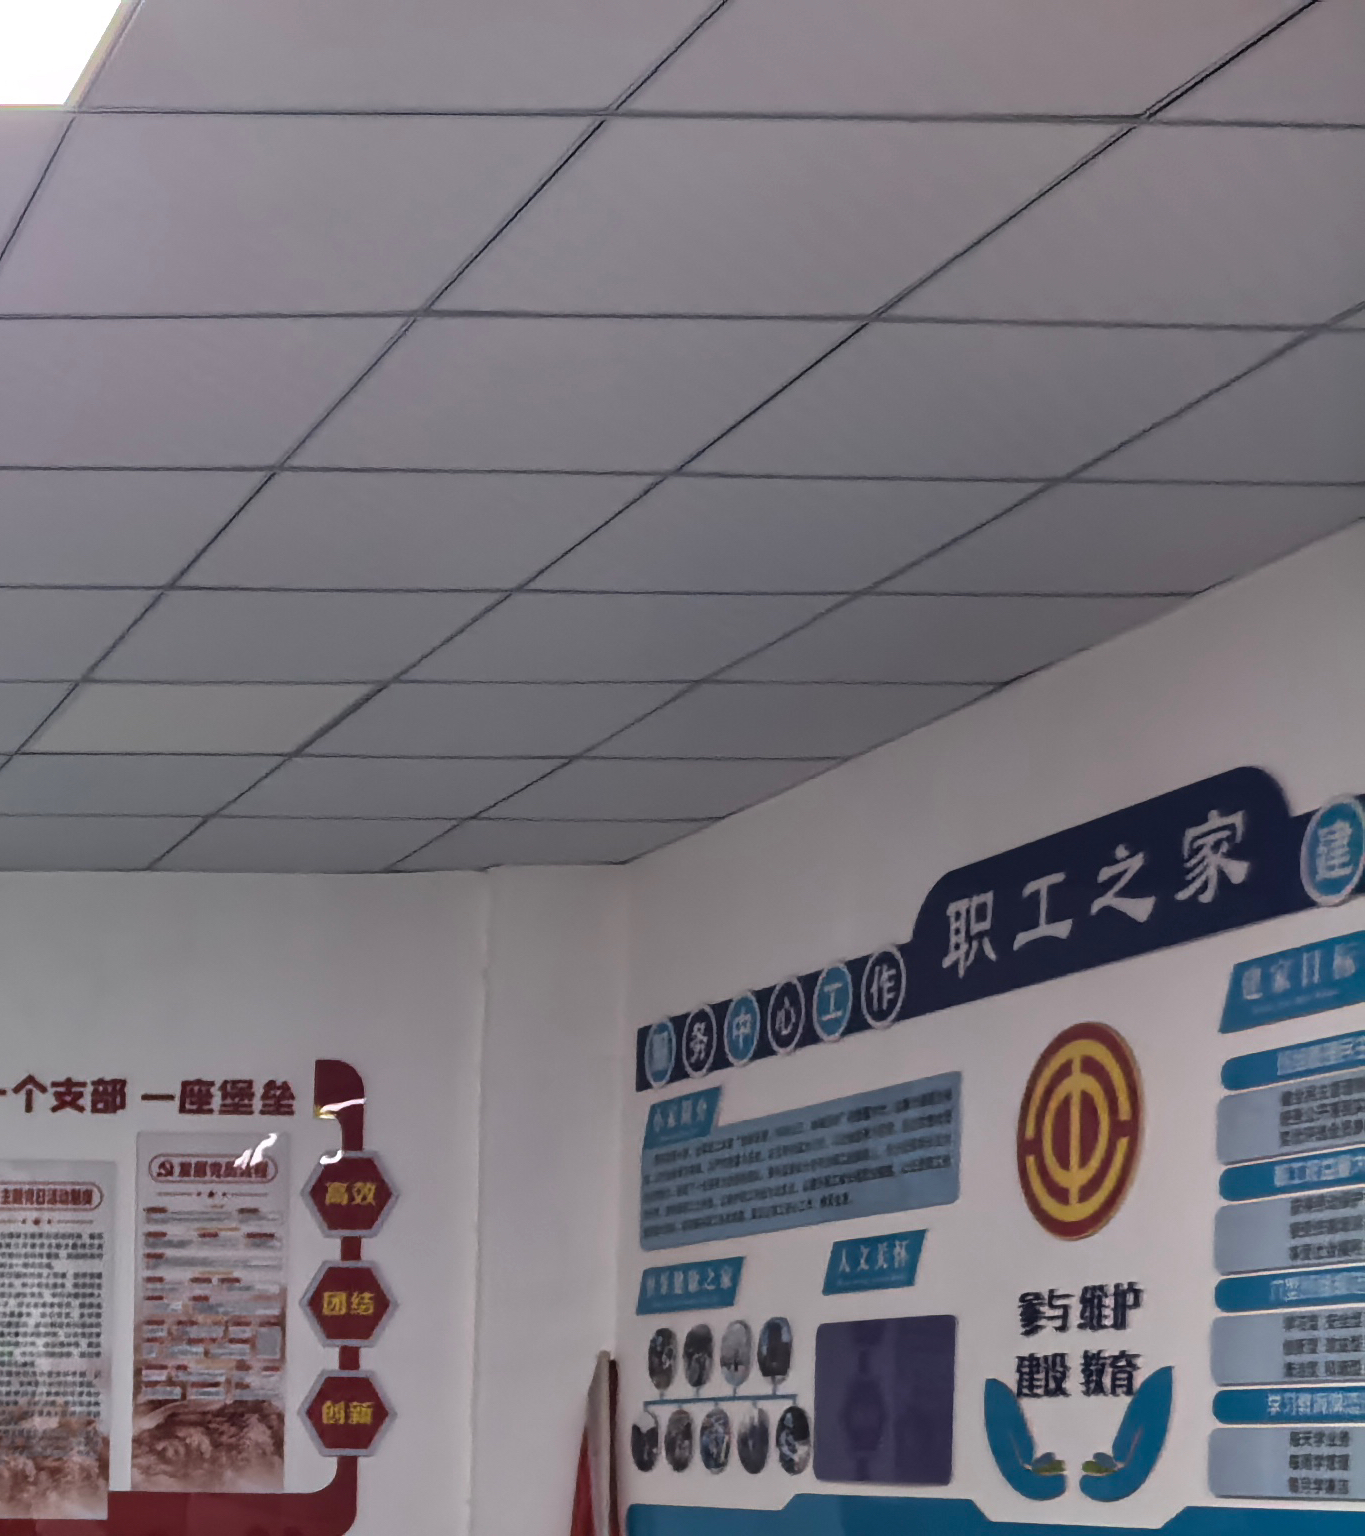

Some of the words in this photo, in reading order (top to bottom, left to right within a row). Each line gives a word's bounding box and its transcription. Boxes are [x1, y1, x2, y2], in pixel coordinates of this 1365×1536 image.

[942, 808, 1251, 979] 职工之家
[140, 1078, 295, 1116] 一座堡垒
[322, 1291, 375, 1316] 团结
[1016, 1353, 1071, 1398] 建设
[1080, 1349, 1142, 1397] 教育
[322, 1400, 374, 1425] 创新
